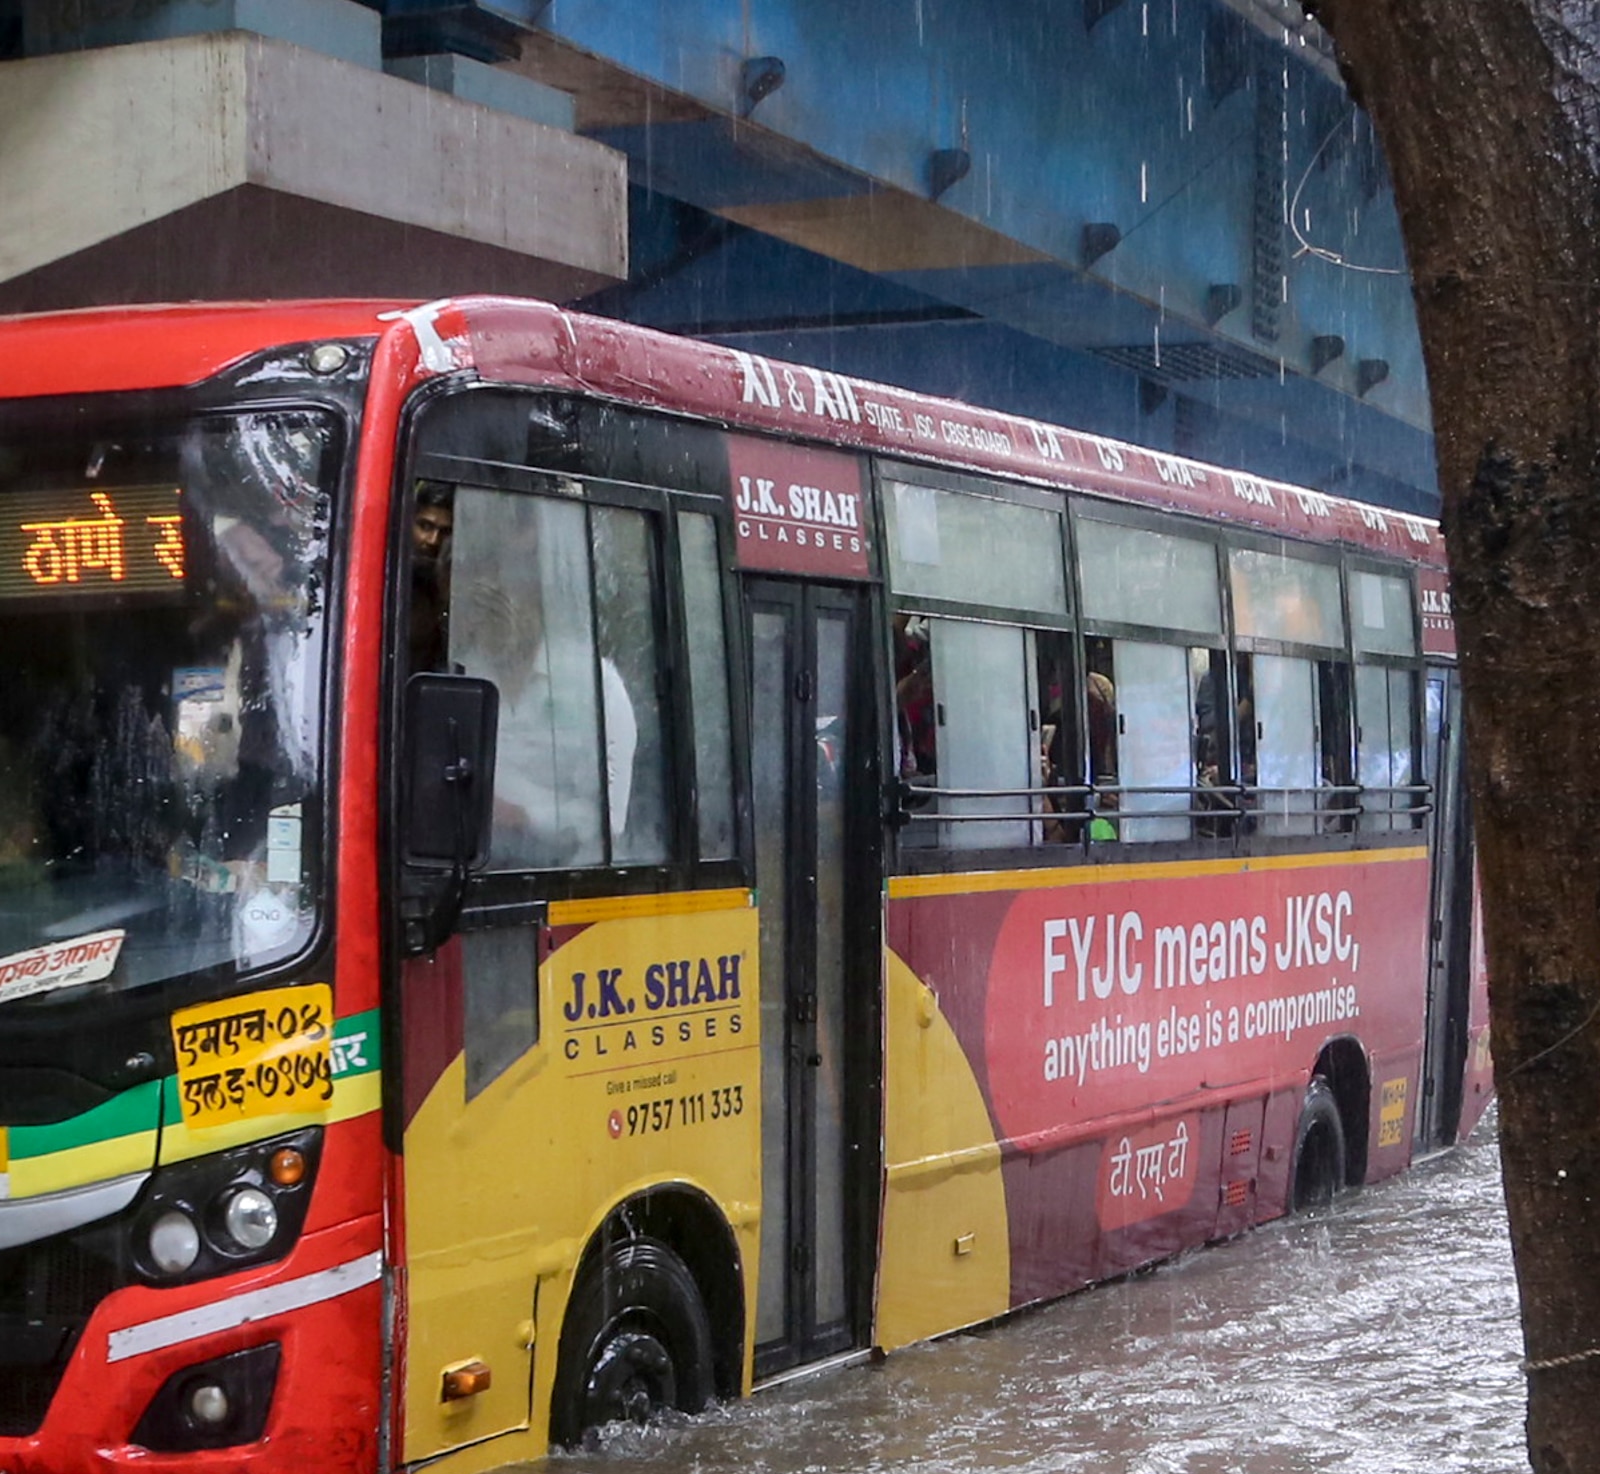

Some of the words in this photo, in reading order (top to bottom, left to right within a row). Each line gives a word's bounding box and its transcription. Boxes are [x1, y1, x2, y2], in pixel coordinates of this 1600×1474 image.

[732, 350, 782, 408] XI
[783, 369, 808, 413] &
[802, 365, 861, 425] XII
[913, 413, 936, 439] ISC
[941, 420, 975, 449] CBSE
[971, 426, 1012, 456] BOARD
[1030, 421, 1065, 461] CA
[1096, 440, 1124, 472] CS
[1153, 456, 1195, 488] CMA
[1230, 475, 1276, 507] ACCA
[736, 475, 785, 516] J.K.
[788, 483, 858, 527] SHAH
[20, 491, 125, 584] ठाणे
[738, 521, 861, 553] CLASSES
[48, 935, 126, 970] आगार
[1043, 911, 1143, 1007] FYJC
[1154, 915, 1268, 989] means
[1275, 890, 1360, 972] JKSC,
[563, 967, 636, 1022] J.K.
[644, 954, 741, 1011] SHAH
[563, 1014, 743, 1060] CLASSES
[1043, 1015, 1151, 1087] anything
[1157, 1006, 1201, 1058] else
[1205, 1000, 1222, 1048] is
[1228, 1006, 1239, 1043] a
[1244, 978, 1360, 1042] compromise.
[606, 1079, 625, 1096] Give
[626, 1079, 631, 1092] a
[632, 1071, 662, 1092] missed
[663, 1069, 677, 1086] call
[627, 1098, 674, 1137] 9757
[680, 1093, 704, 1126] 111
[711, 1085, 744, 1120] 333
